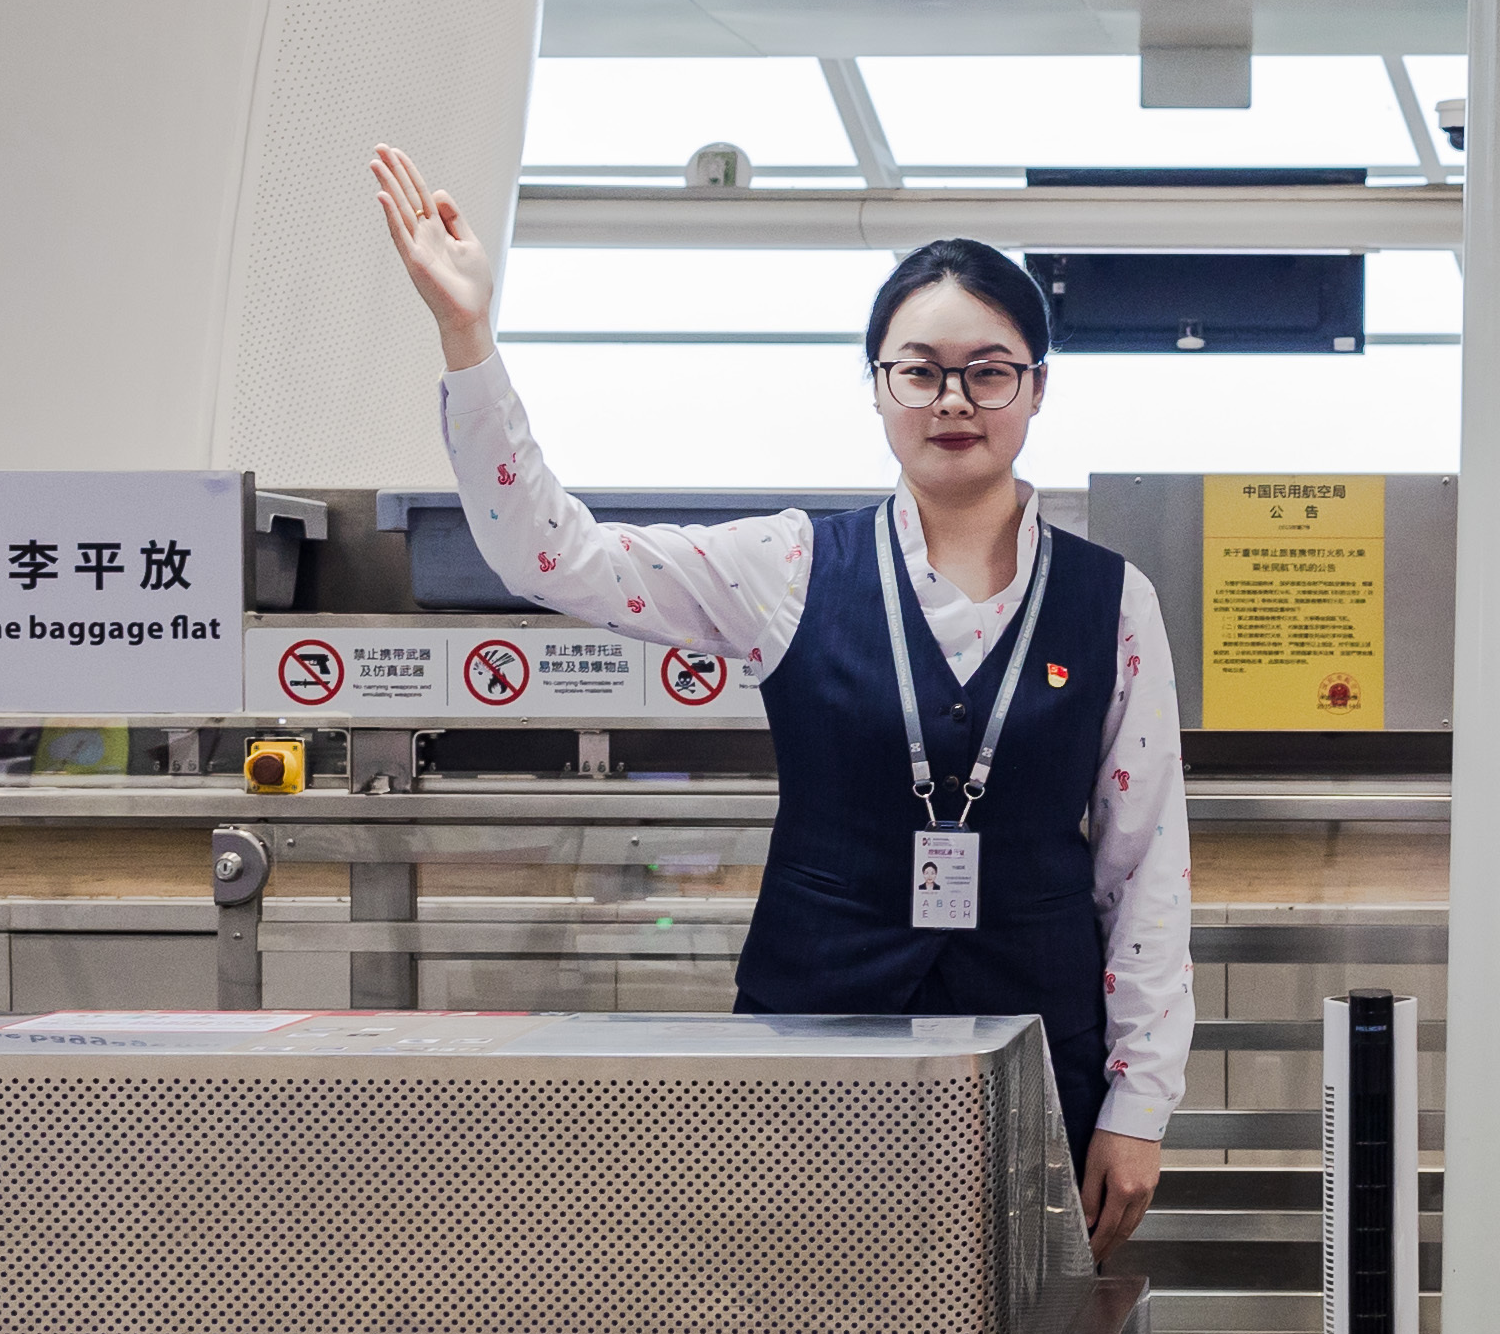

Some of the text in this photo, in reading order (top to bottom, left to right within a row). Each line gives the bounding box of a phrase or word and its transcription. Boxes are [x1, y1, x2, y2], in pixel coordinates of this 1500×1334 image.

[1243, 485, 1345, 498] 中国民用航空局
[30, 615, 163, 645] baggage
[171, 615, 220, 639] flat
